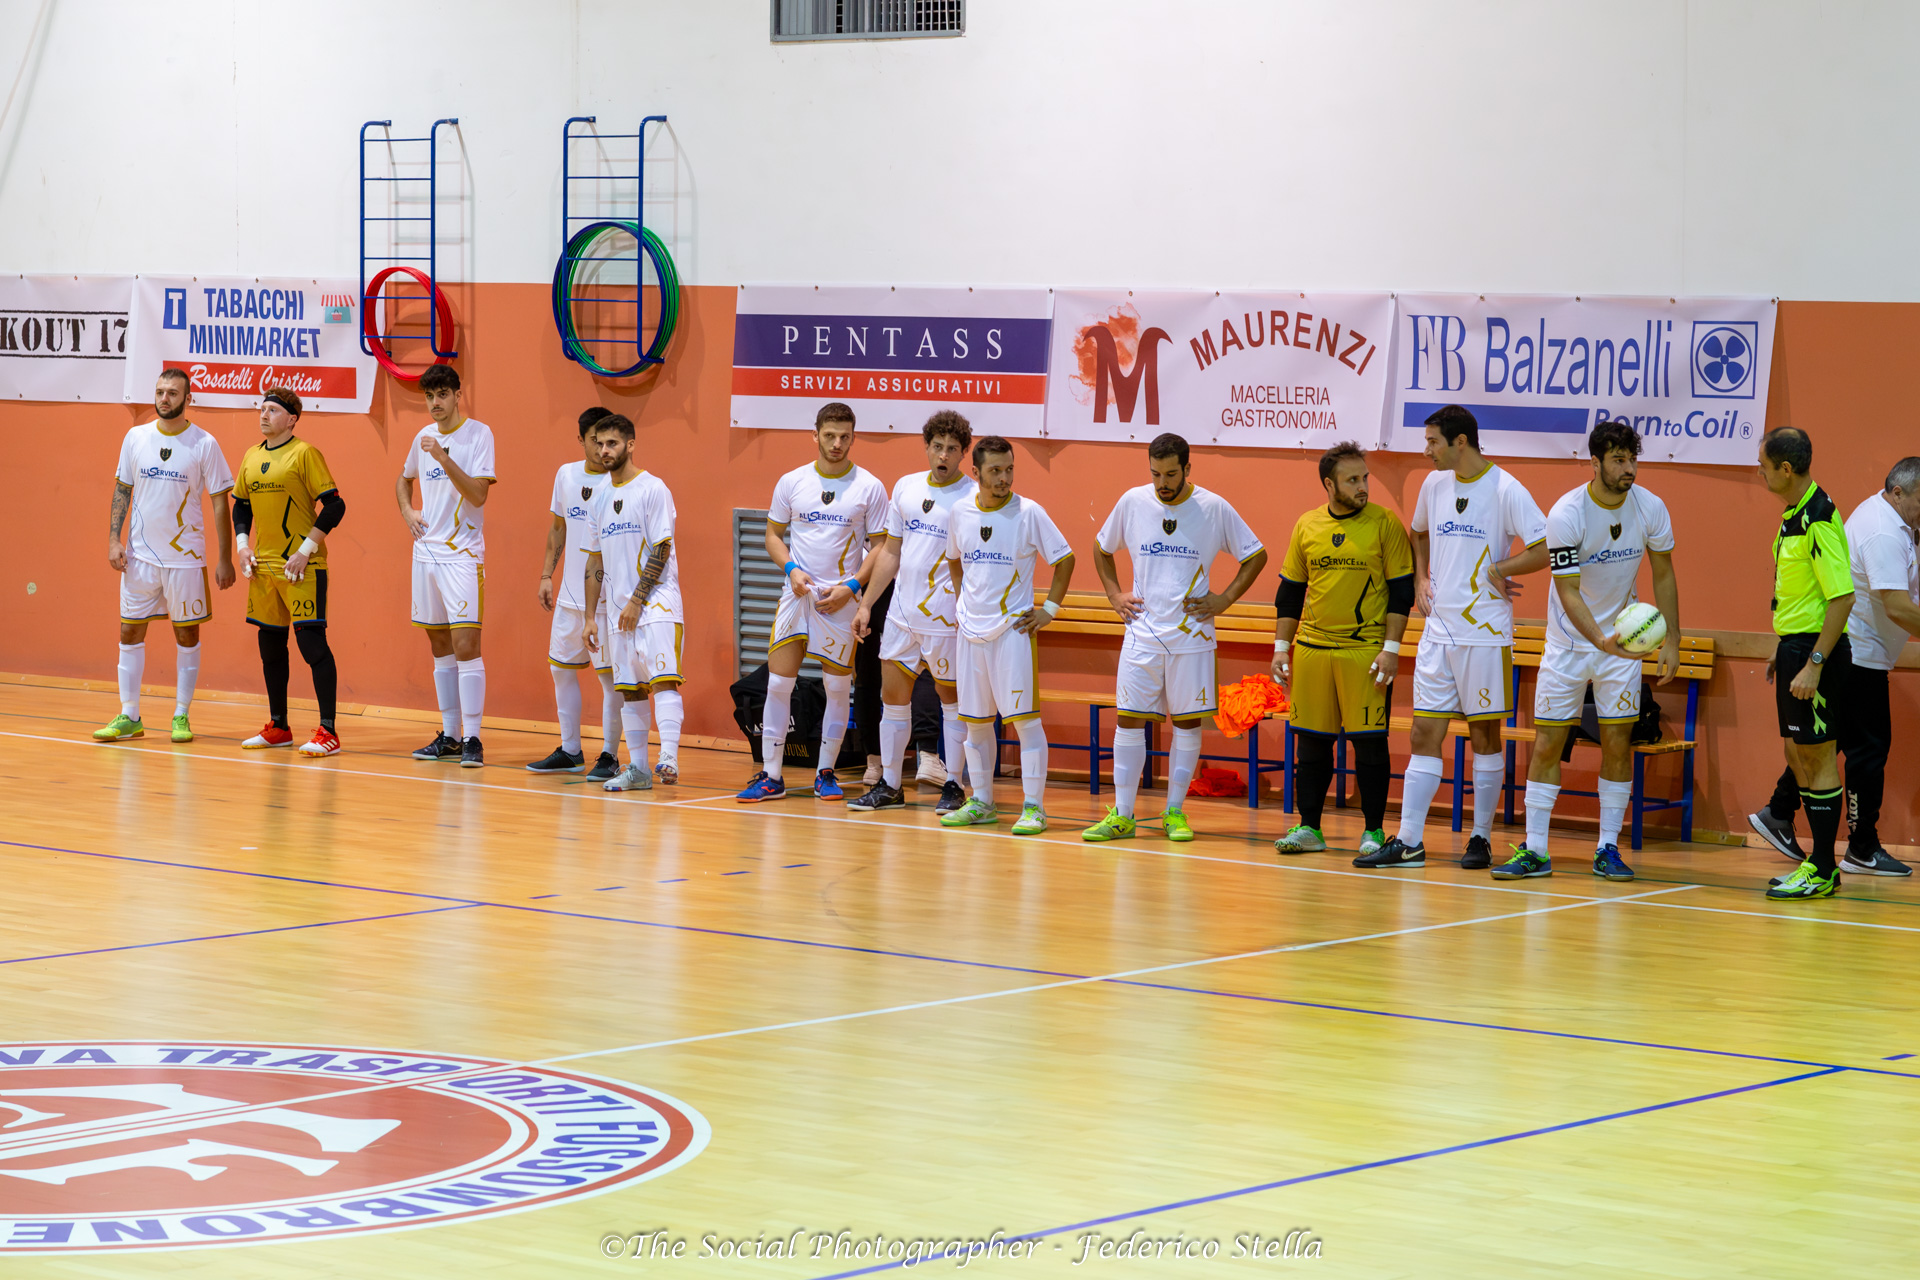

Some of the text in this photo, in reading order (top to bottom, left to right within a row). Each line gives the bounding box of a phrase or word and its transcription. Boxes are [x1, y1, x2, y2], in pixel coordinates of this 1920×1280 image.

[204, 288, 304, 321] TABACCHI
[100, 319, 129, 353] 17
[189, 324, 321, 358] MINIMARKET
[782, 325, 1003, 360] PENTASS
[1190, 310, 1377, 376] MAURENZI
[1405, 314, 1466, 391] FB
[1485, 317, 1672, 398] Balzanelli
[190, 364, 322, 395] Rosatelli Cristian
[780, 375, 1001, 395] SERVIZI ASSICURATIVI
[1230, 385, 1331, 406] MACELLERIA
[1221, 408, 1337, 430] GASTRONOMIA
[1140, 542, 1188, 554] ALLSERVICE
[181, 598, 204, 617] 10
[292, 599, 315, 617] 29
[456, 600, 468, 618] 2
[821, 637, 848, 661] 21
[655, 652, 666, 671] 6
[936, 657, 949, 676] 9
[1011, 690, 1024, 710] 7
[1195, 685, 1208, 706] 4
[1478, 688, 1491, 709] 8
[1362, 705, 1385, 727] 12
[157, 1048, 636, 1115] TRASPORTI
[7, 1121, 659, 1244] FOSSOMBRONE
